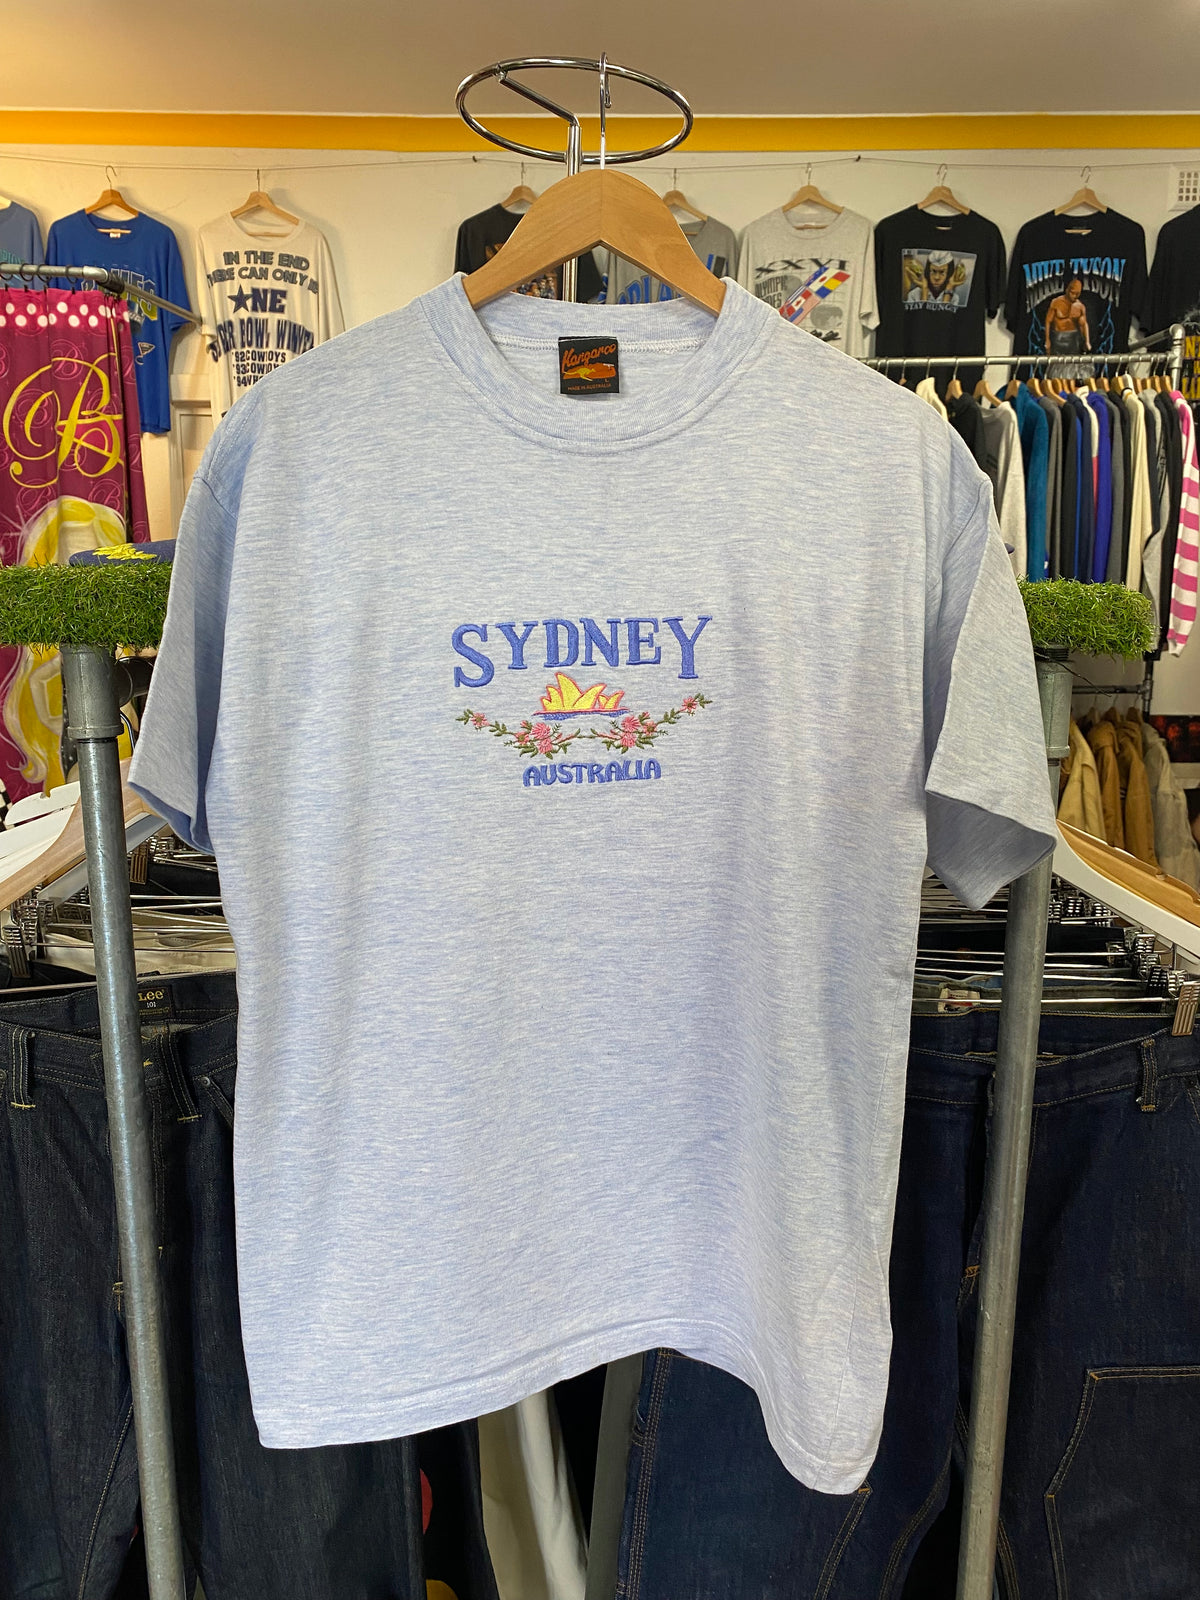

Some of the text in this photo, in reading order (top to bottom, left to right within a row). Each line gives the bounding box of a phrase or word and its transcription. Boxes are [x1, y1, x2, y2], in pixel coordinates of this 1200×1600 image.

[223, 250, 310, 271] IN THE END
[238, 267, 269, 280] CAN
[272, 268, 308, 286] ONLY
[1023, 257, 1126, 313] MIKE TYSON
[245, 350, 287, 363] COWOYS
[451, 615, 713, 688] SYDNEY
[523, 757, 662, 787] AUSTRALIA
